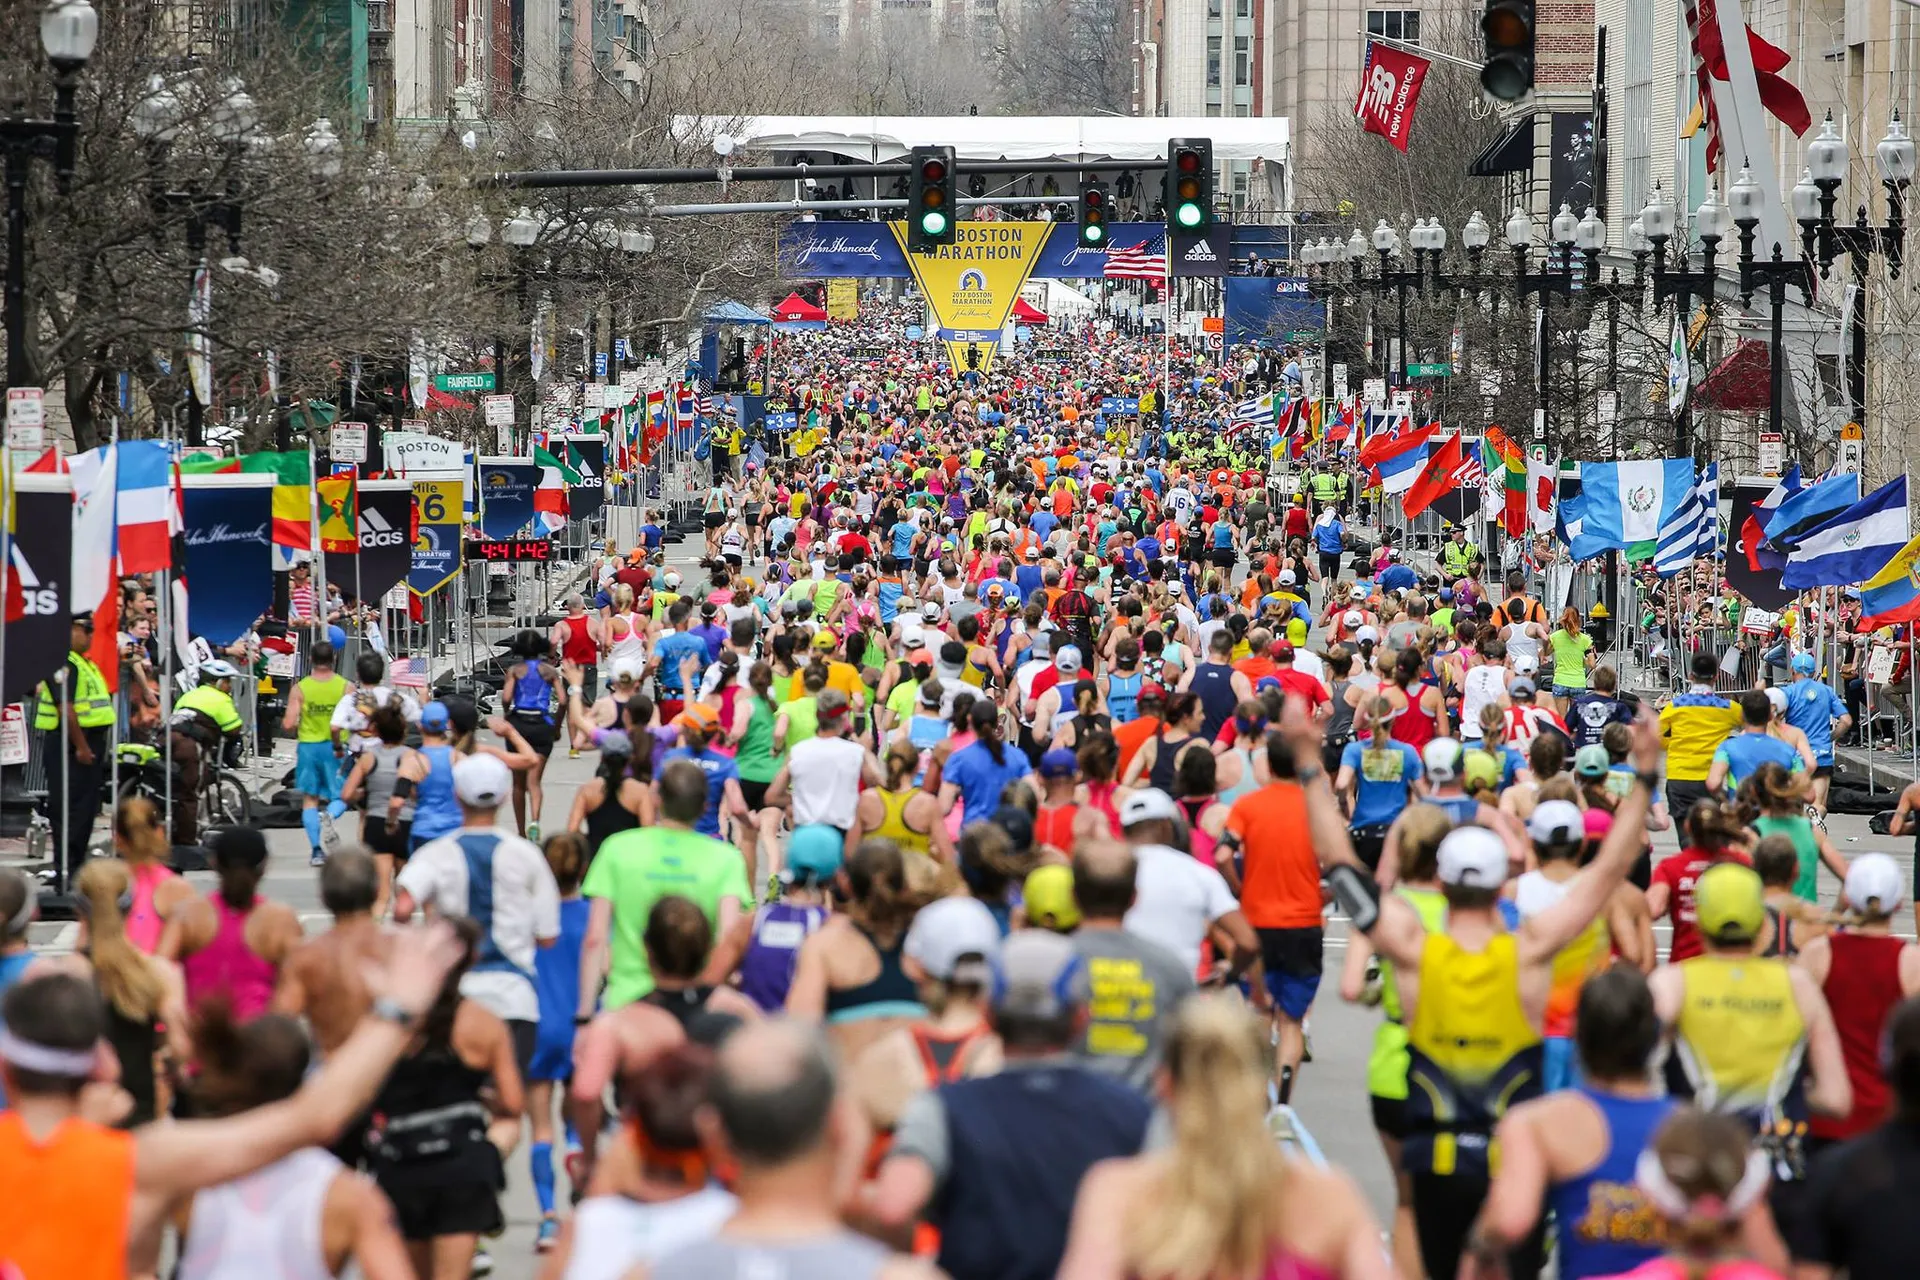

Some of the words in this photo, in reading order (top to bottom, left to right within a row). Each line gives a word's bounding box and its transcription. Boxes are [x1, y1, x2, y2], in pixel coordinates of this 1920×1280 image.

[1393, 66, 1416, 112] balance
[1389, 113, 1402, 138] new
[956, 228, 1022, 242] BOSTON
[795, 237, 830, 265] John
[829, 236, 882, 260] Hancock
[1184, 251, 1217, 261] adidas
[1420, 366, 1434, 375] RING
[447, 376, 484, 388] FAIRFIELD
[1116, 399, 1125, 412] 3
[775, 415, 784, 428] 3
[1849, 427, 1854, 435] T
[397, 442, 450, 455] BOSTON
[412, 483, 438, 493] Mile
[1174, 497, 1186, 509] 16
[206, 522, 271, 546] Hancock
